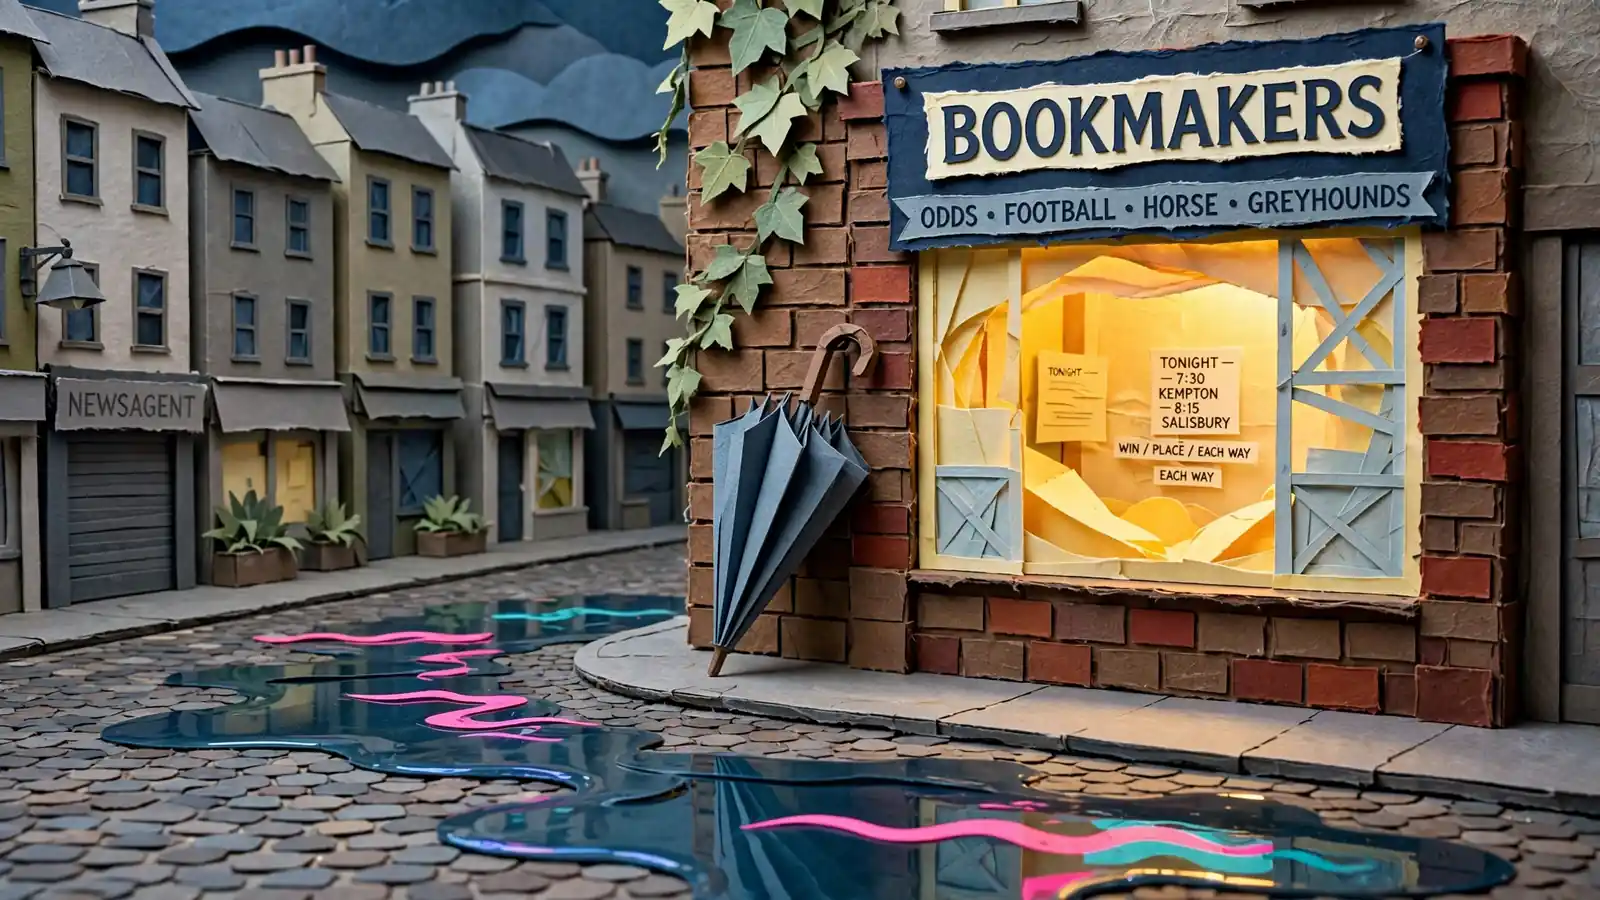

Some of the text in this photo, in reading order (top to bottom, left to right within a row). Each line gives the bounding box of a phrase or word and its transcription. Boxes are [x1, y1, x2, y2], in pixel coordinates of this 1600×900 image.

[941, 74, 1386, 165] BOOKMAKERS
[920, 204, 978, 229] ODDS
[1004, 196, 1116, 226] FOOTBALL
[1143, 192, 1218, 219] HORSE
[1247, 183, 1411, 215] GREYHOUNDS
[1159, 356, 1219, 369] TONIGHT
[1176, 372, 1205, 385] 7:30
[1158, 387, 1218, 400] KEMPTON
[68, 391, 196, 419] NEWSAGENT
[1174, 402, 1200, 414] 8:15
[1161, 416, 1231, 429] SALISBURY
[1118, 442, 1140, 454] WIN
[1152, 444, 1185, 456] PLACE
[1198, 446, 1224, 458] EACH
[1228, 447, 1251, 459] WAY
[1159, 469, 1215, 483] EACH WAY
